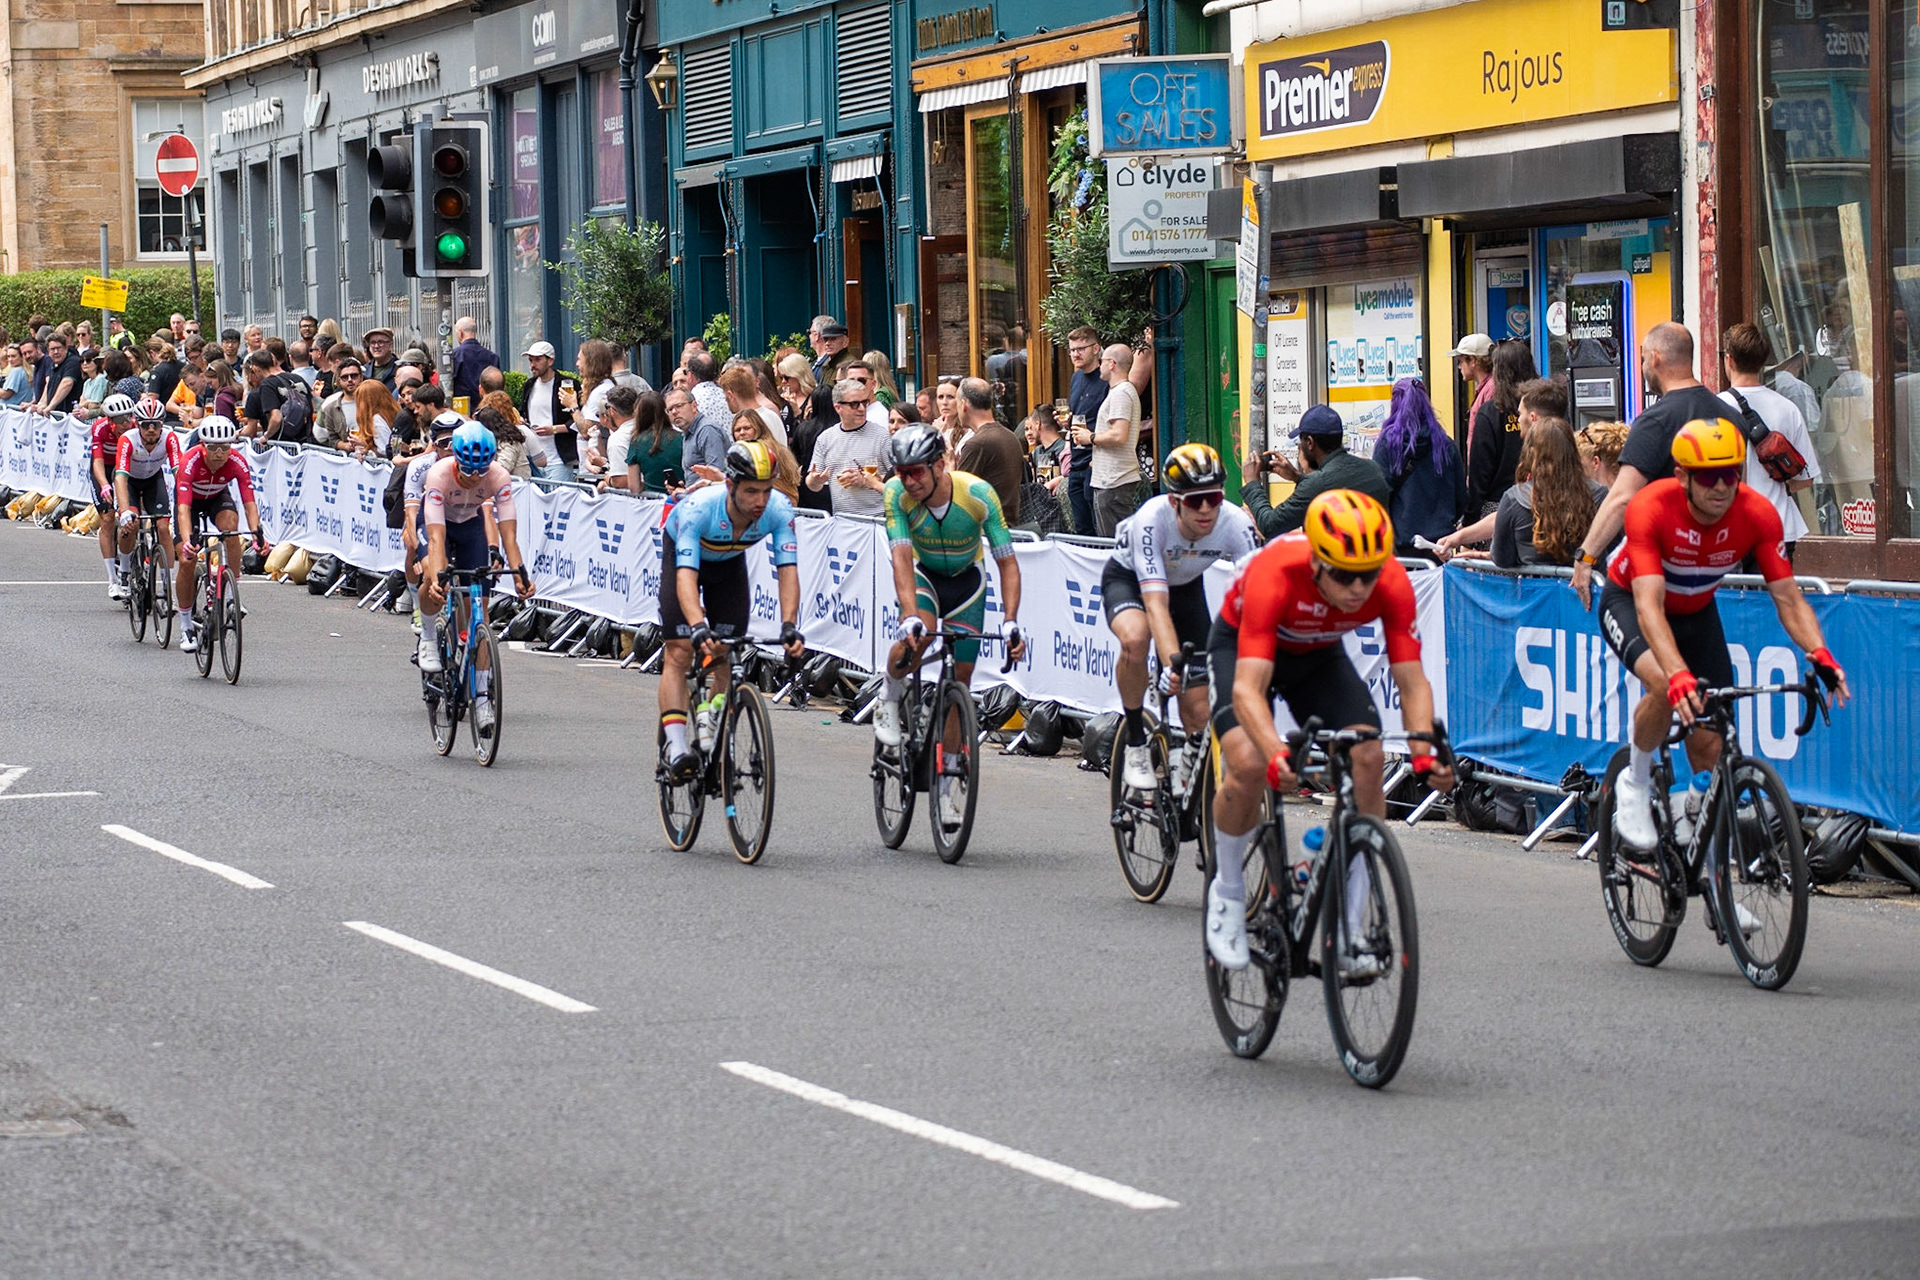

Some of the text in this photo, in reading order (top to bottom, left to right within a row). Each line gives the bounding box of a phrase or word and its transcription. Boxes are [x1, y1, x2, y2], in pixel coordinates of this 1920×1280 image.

[362, 52, 434, 94] DESIGNWORKS
[1483, 49, 1563, 104] Rajous
[1130, 72, 1198, 106] OFF
[1264, 61, 1384, 132] Premier express
[1116, 107, 1218, 145] SALES
[1142, 163, 1206, 189] clyde
[1164, 190, 1207, 199] PROPERTY
[1160, 215, 1208, 226] FOR SALE
[1132, 229, 1159, 242] 0141
[1354, 278, 1414, 316] Lycamobile
[1571, 298, 1613, 322] free cash
[1571, 322, 1613, 339] withdrawals
[1277, 356, 1297, 370] Groceries
[1339, 343, 1356, 365] Lyca
[1367, 341, 1384, 364] Lyca
[1396, 339, 1414, 362] Lyca
[1339, 363, 1356, 377] mobile
[1368, 362, 1385, 375] mobile
[1396, 360, 1415, 374] mobile
[1272, 378, 1302, 393] Chilled Drinks
[1273, 400, 1302, 415] Frozen Foods
[1273, 423, 1287, 437] News
[119, 441, 129, 471] PORTUGAL
[169, 436, 180, 466] PORTUGAL
[410, 462, 432, 482] Cofidis
[316, 507, 344, 544] Peter Vardy
[351, 516, 381, 553] Peter Vardy
[554, 549, 577, 587] Vardy
[587, 557, 631, 602] Peter Vardy
[751, 584, 778, 621] Peter
[830, 592, 866, 640] Vardy
[1602, 608, 1625, 652] NOR
[1054, 630, 1115, 687] Peter Vardy
